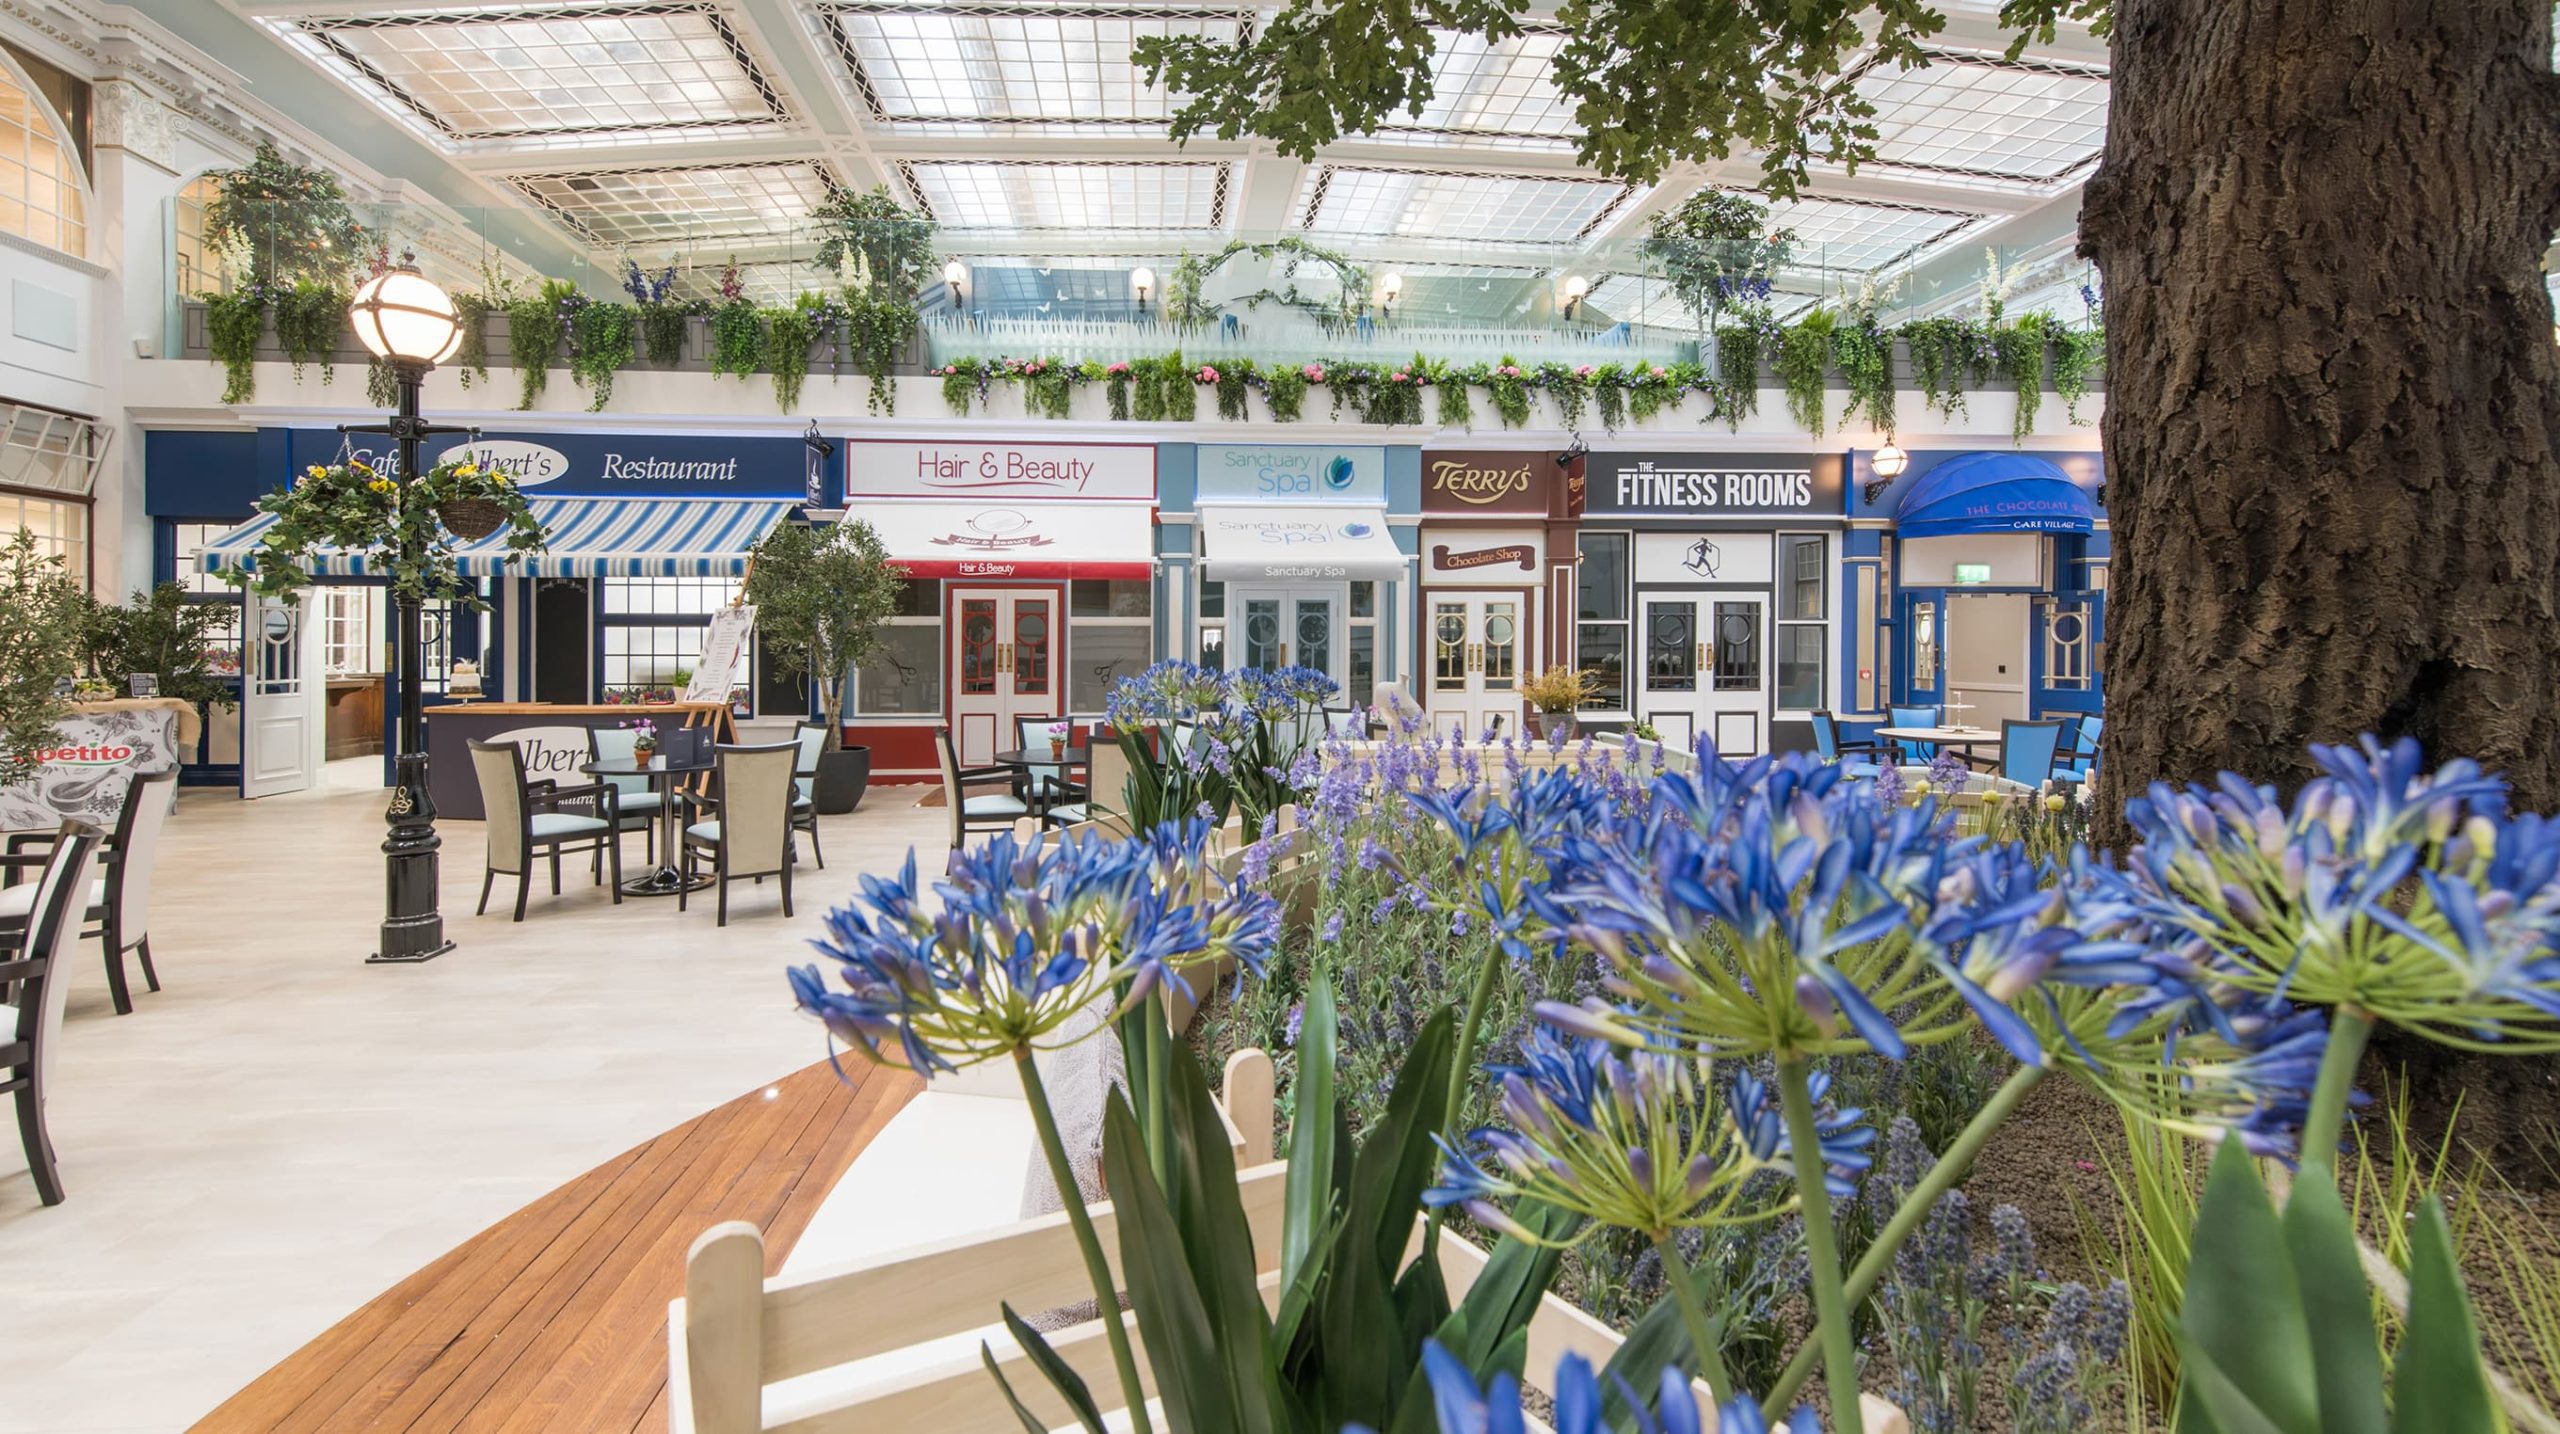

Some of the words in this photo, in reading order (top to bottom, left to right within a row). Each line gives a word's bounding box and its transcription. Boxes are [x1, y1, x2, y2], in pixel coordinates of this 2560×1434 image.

[477, 449, 552, 476] lbert's
[601, 453, 737, 481] Restaurant
[1224, 451, 1312, 471] Sanctuary
[1638, 461, 1655, 474] THE
[918, 450, 970, 479] Hair
[979, 451, 998, 479] &
[1007, 451, 1095, 493] Beauty
[1257, 467, 1312, 497] Spa
[1617, 473, 1718, 507] FITNESS
[1724, 474, 1812, 507] ROOMS
[1967, 505, 1991, 517] THE
[1219, 521, 1323, 532] Sanctuary
[2013, 520, 2043, 530] CARE
[2045, 521, 2076, 530] VILLAGE
[1260, 531, 1327, 545] Spa
[1447, 555, 1496, 568] Chocolate
[1495, 548, 1522, 562] Shop
[959, 562, 977, 573] Hair
[986, 562, 1016, 576] Beauty
[1264, 566, 1322, 578] Sanctuary
[1324, 566, 1346, 578] Spa
[13, 742, 131, 765] petito
[524, 739, 594, 773] lbert
